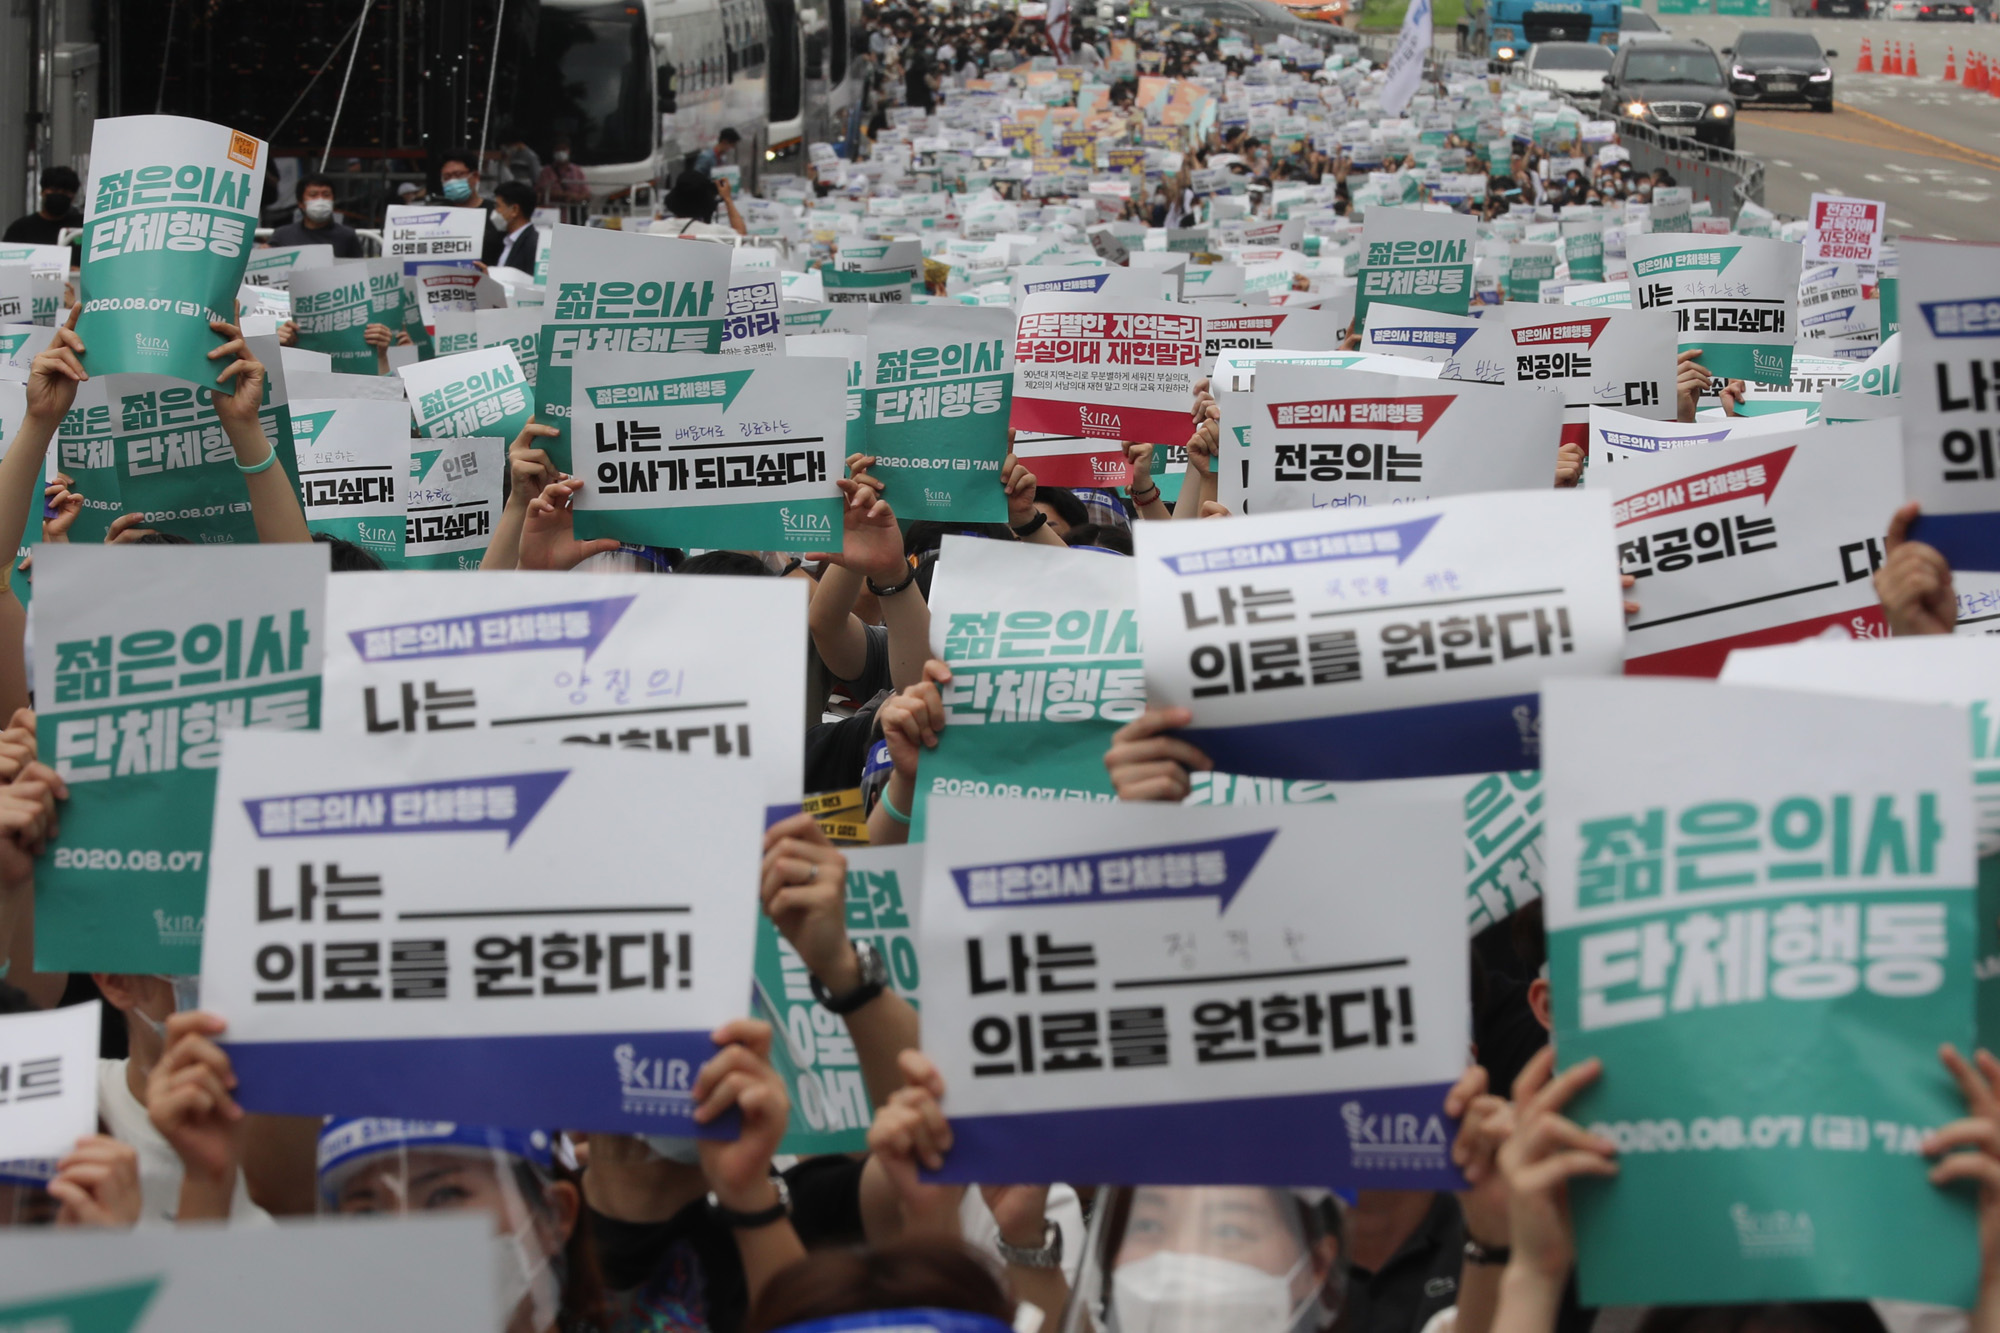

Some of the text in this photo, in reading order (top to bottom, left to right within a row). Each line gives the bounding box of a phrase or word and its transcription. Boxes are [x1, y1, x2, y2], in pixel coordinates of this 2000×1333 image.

[95, 165, 251, 214] 젊은의사
[89, 211, 245, 263] 단체행동
[392, 241, 472, 255] 의료를 원한다!
[393, 230, 416, 240] 나는
[1367, 239, 1467, 266] 젊은의사
[1637, 252, 1721, 275] 젊은의사 단체행동
[427, 288, 477, 304] 전공의는
[1364, 269, 1464, 296] 단체행동
[1639, 283, 1673, 310] 나는
[84, 298, 171, 314] 2020.08.07
[175, 300, 200, 317] (금)
[295, 281, 366, 314] 젊은의사
[555, 280, 716, 320] 젊은의사
[297, 304, 369, 334] 단체행동
[1019, 315, 1200, 343] 무분별한 지역논리
[1694, 308, 1785, 333] 되고싶다!
[140, 338, 169, 349] KIRA
[1374, 328, 1457, 345] 젊은의사 단체행동
[1516, 325, 1592, 343] 젊은의사 단체행동
[876, 340, 1004, 384] 젊은의사
[1015, 340, 1202, 367] 부실의대 재현말라
[1517, 353, 1592, 381] 전공의는
[1760, 356, 1785, 369] KIRA
[1023, 370, 1191, 383] 90년대 지역논리로 무분별하게 세워진 부실의대,
[1024, 381, 1189, 393] 제2의의 서남의대 재현 말고 의대 교육 지원하라
[419, 364, 516, 420] 젊은의사
[596, 379, 727, 405] 젊은의사 단체행동
[875, 380, 1004, 425] 단체행동
[1624, 381, 1659, 406] 다!
[429, 387, 527, 439] 단체행동
[1086, 413, 1121, 427] KIRA
[1277, 403, 1424, 425] 젊은의사 단체행동
[595, 420, 662, 453] 나는
[675, 420, 792, 441] 배운대로 진료하는
[1606, 433, 1656, 451] 젊은의사
[443, 452, 478, 482] 인턴
[597, 450, 827, 494] 의사가 되고싶다!
[875, 456, 999, 471] 2020.08.07 (금) 7AM
[1098, 461, 1126, 472] KIRA
[1274, 443, 1423, 482] 전공의는
[929, 491, 952, 500] KIRA
[1688, 464, 1768, 503] 단체행동
[363, 527, 396, 541] KIRA
[789, 514, 831, 529] KIRA
[1618, 514, 1779, 580] 전공의는
[1180, 584, 1296, 631] 나는
[363, 611, 591, 660] 젊은의사 단체행동
[55, 609, 310, 704] 젊은의사
[1189, 606, 1574, 699] 의료를 원한다!
[363, 680, 477, 735] 나는
[941, 667, 1148, 726] 단체행동
[261, 785, 518, 836] 젊은의사 단체행동
[54, 847, 204, 872] 2020.08.07
[1576, 791, 1944, 910] 젊은의사
[966, 849, 1227, 904] 젊은의사 단체행동
[255, 862, 384, 923] 나는
[254, 931, 693, 1003] 의료를 원한다!
[965, 932, 1097, 996] 나는
[1578, 902, 1948, 1033] 단체행동
[971, 986, 1417, 1077] 의료를 원한다!
[1357, 1113, 1447, 1145] KIRA
